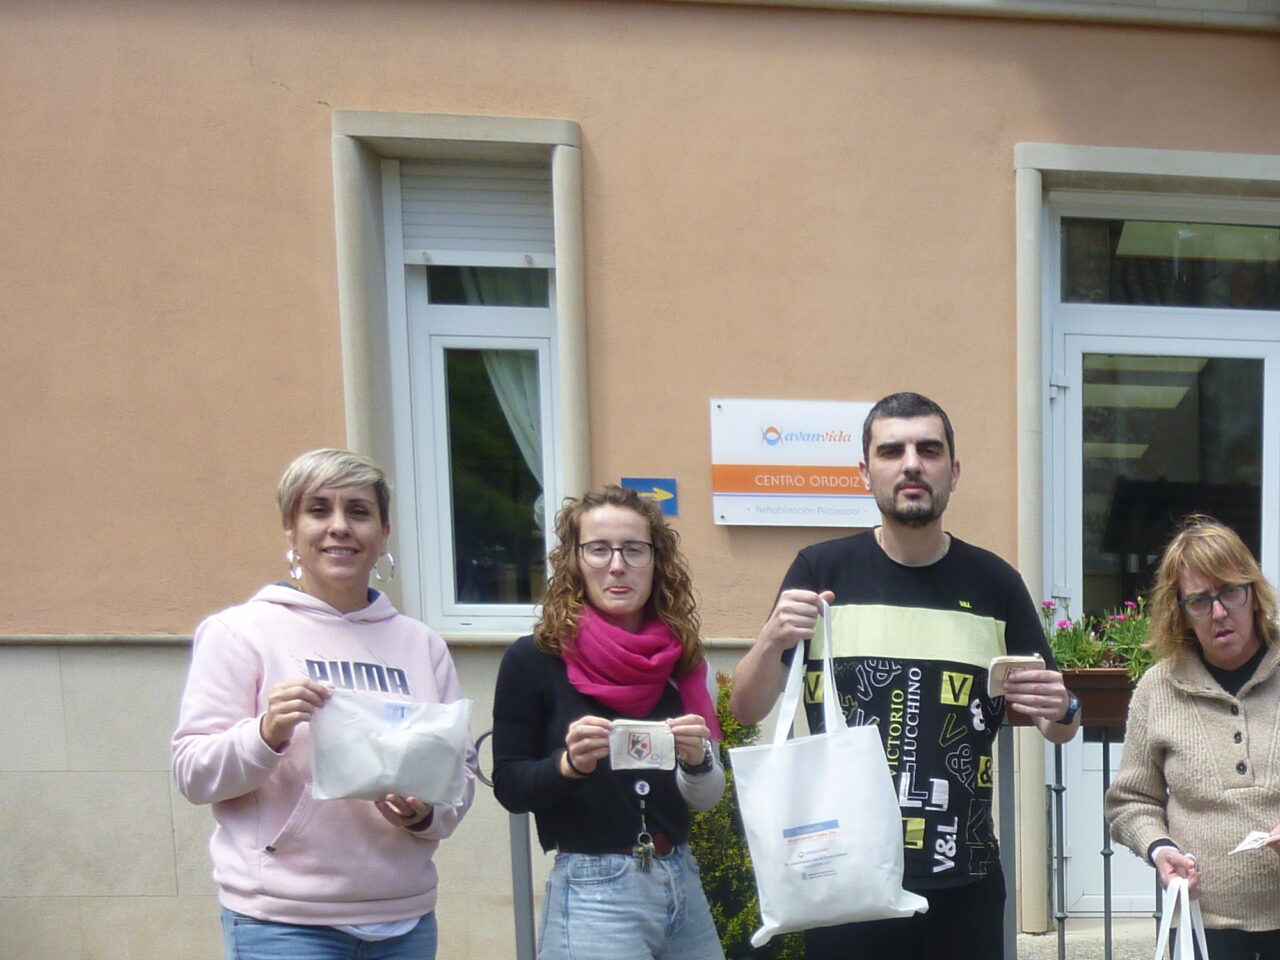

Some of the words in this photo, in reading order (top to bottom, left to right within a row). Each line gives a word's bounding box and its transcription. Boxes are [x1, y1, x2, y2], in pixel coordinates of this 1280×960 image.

[785, 430, 852, 443] avanvida
[755, 474, 805, 487] CENTRO
[809, 476, 861, 488] ORDOIZ
[305, 659, 411, 696] PUMA
[948, 674, 969, 703] V
[902, 667, 922, 763] LUCCHINO
[932, 816, 959, 873] V&L
